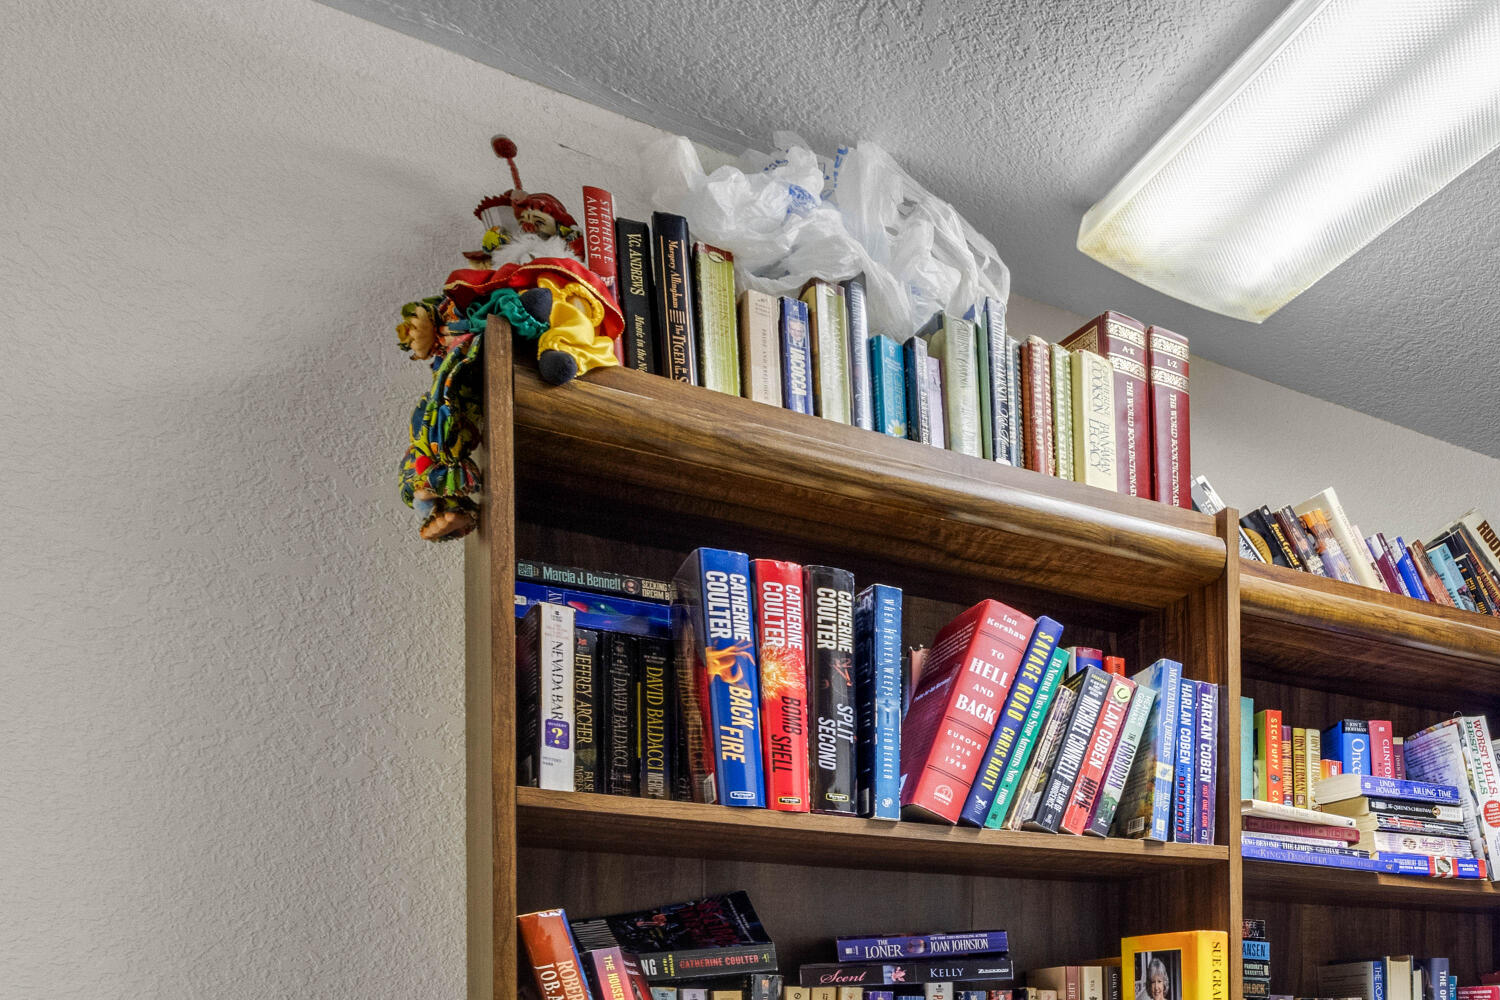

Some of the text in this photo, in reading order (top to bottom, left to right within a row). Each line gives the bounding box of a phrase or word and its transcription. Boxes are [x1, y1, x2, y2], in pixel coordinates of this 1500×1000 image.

[587, 196, 601, 260] AMBROSE
[600, 201, 613, 255] STEPHEN
[630, 249, 644, 296] ANDREWS
[672, 335, 687, 364] TIGER
[790, 346, 807, 396] IACOCCA
[1128, 452, 1136, 496] DICTIONAR
[543, 567, 621, 590] Marcia J. Bennett
[705, 571, 731, 639] COULTER
[729, 573, 750, 641] CATHERINE
[762, 581, 785, 649] COULTER
[785, 585, 802, 650] CATHERINE
[816, 588, 837, 650] COULTER
[836, 590, 852, 653] CATHERINE
[1002, 614, 1018, 626] Ian
[883, 599, 897, 696] WHEN HEAVEN WEEPS
[986, 616, 1027, 641] Kershaw
[969, 657, 1009, 689] HELL
[990, 648, 1005, 661] TO
[551, 640, 562, 720] NEVADA BAR
[575, 654, 593, 744] JEFFREY ARCHER
[972, 682, 995, 699] AND
[646, 666, 664, 772] DAVID BALDACCI
[728, 685, 753, 728] BACK
[836, 703, 854, 743] SPLIT
[954, 694, 997, 725] BACK
[981, 631, 1054, 791] SAVAGE ROAD CHRIS HAUTY
[1180, 683, 1193, 765] HARLAN COBEN
[720, 726, 746, 763] FIRE
[771, 735, 793, 772] SHELL
[818, 717, 837, 770] SECOND
[946, 729, 982, 750] EUROPE
[1057, 695, 1098, 782] MICHAEL CONNELLY
[1089, 730, 1112, 769] COBEN
[1200, 693, 1213, 782] HARLAN COBEN
[1271, 744, 1279, 769] PUPPY
[1466, 721, 1488, 795] BEST PILLS
[1473, 719, 1489, 759] WORST
[1483, 759, 1498, 794] PILLS
[1414, 787, 1436, 796] KILLING
[604, 956, 615, 971] THE
[680, 954, 759, 968] CATHERINE COULTER
[865, 944, 903, 958] LONER
[930, 938, 988, 952] JOAN JOHNSTON
[1211, 941, 1221, 964] SUE
[534, 963, 556, 996] JOB:
[820, 970, 867, 984] Scent
[930, 968, 964, 978] KELLY
